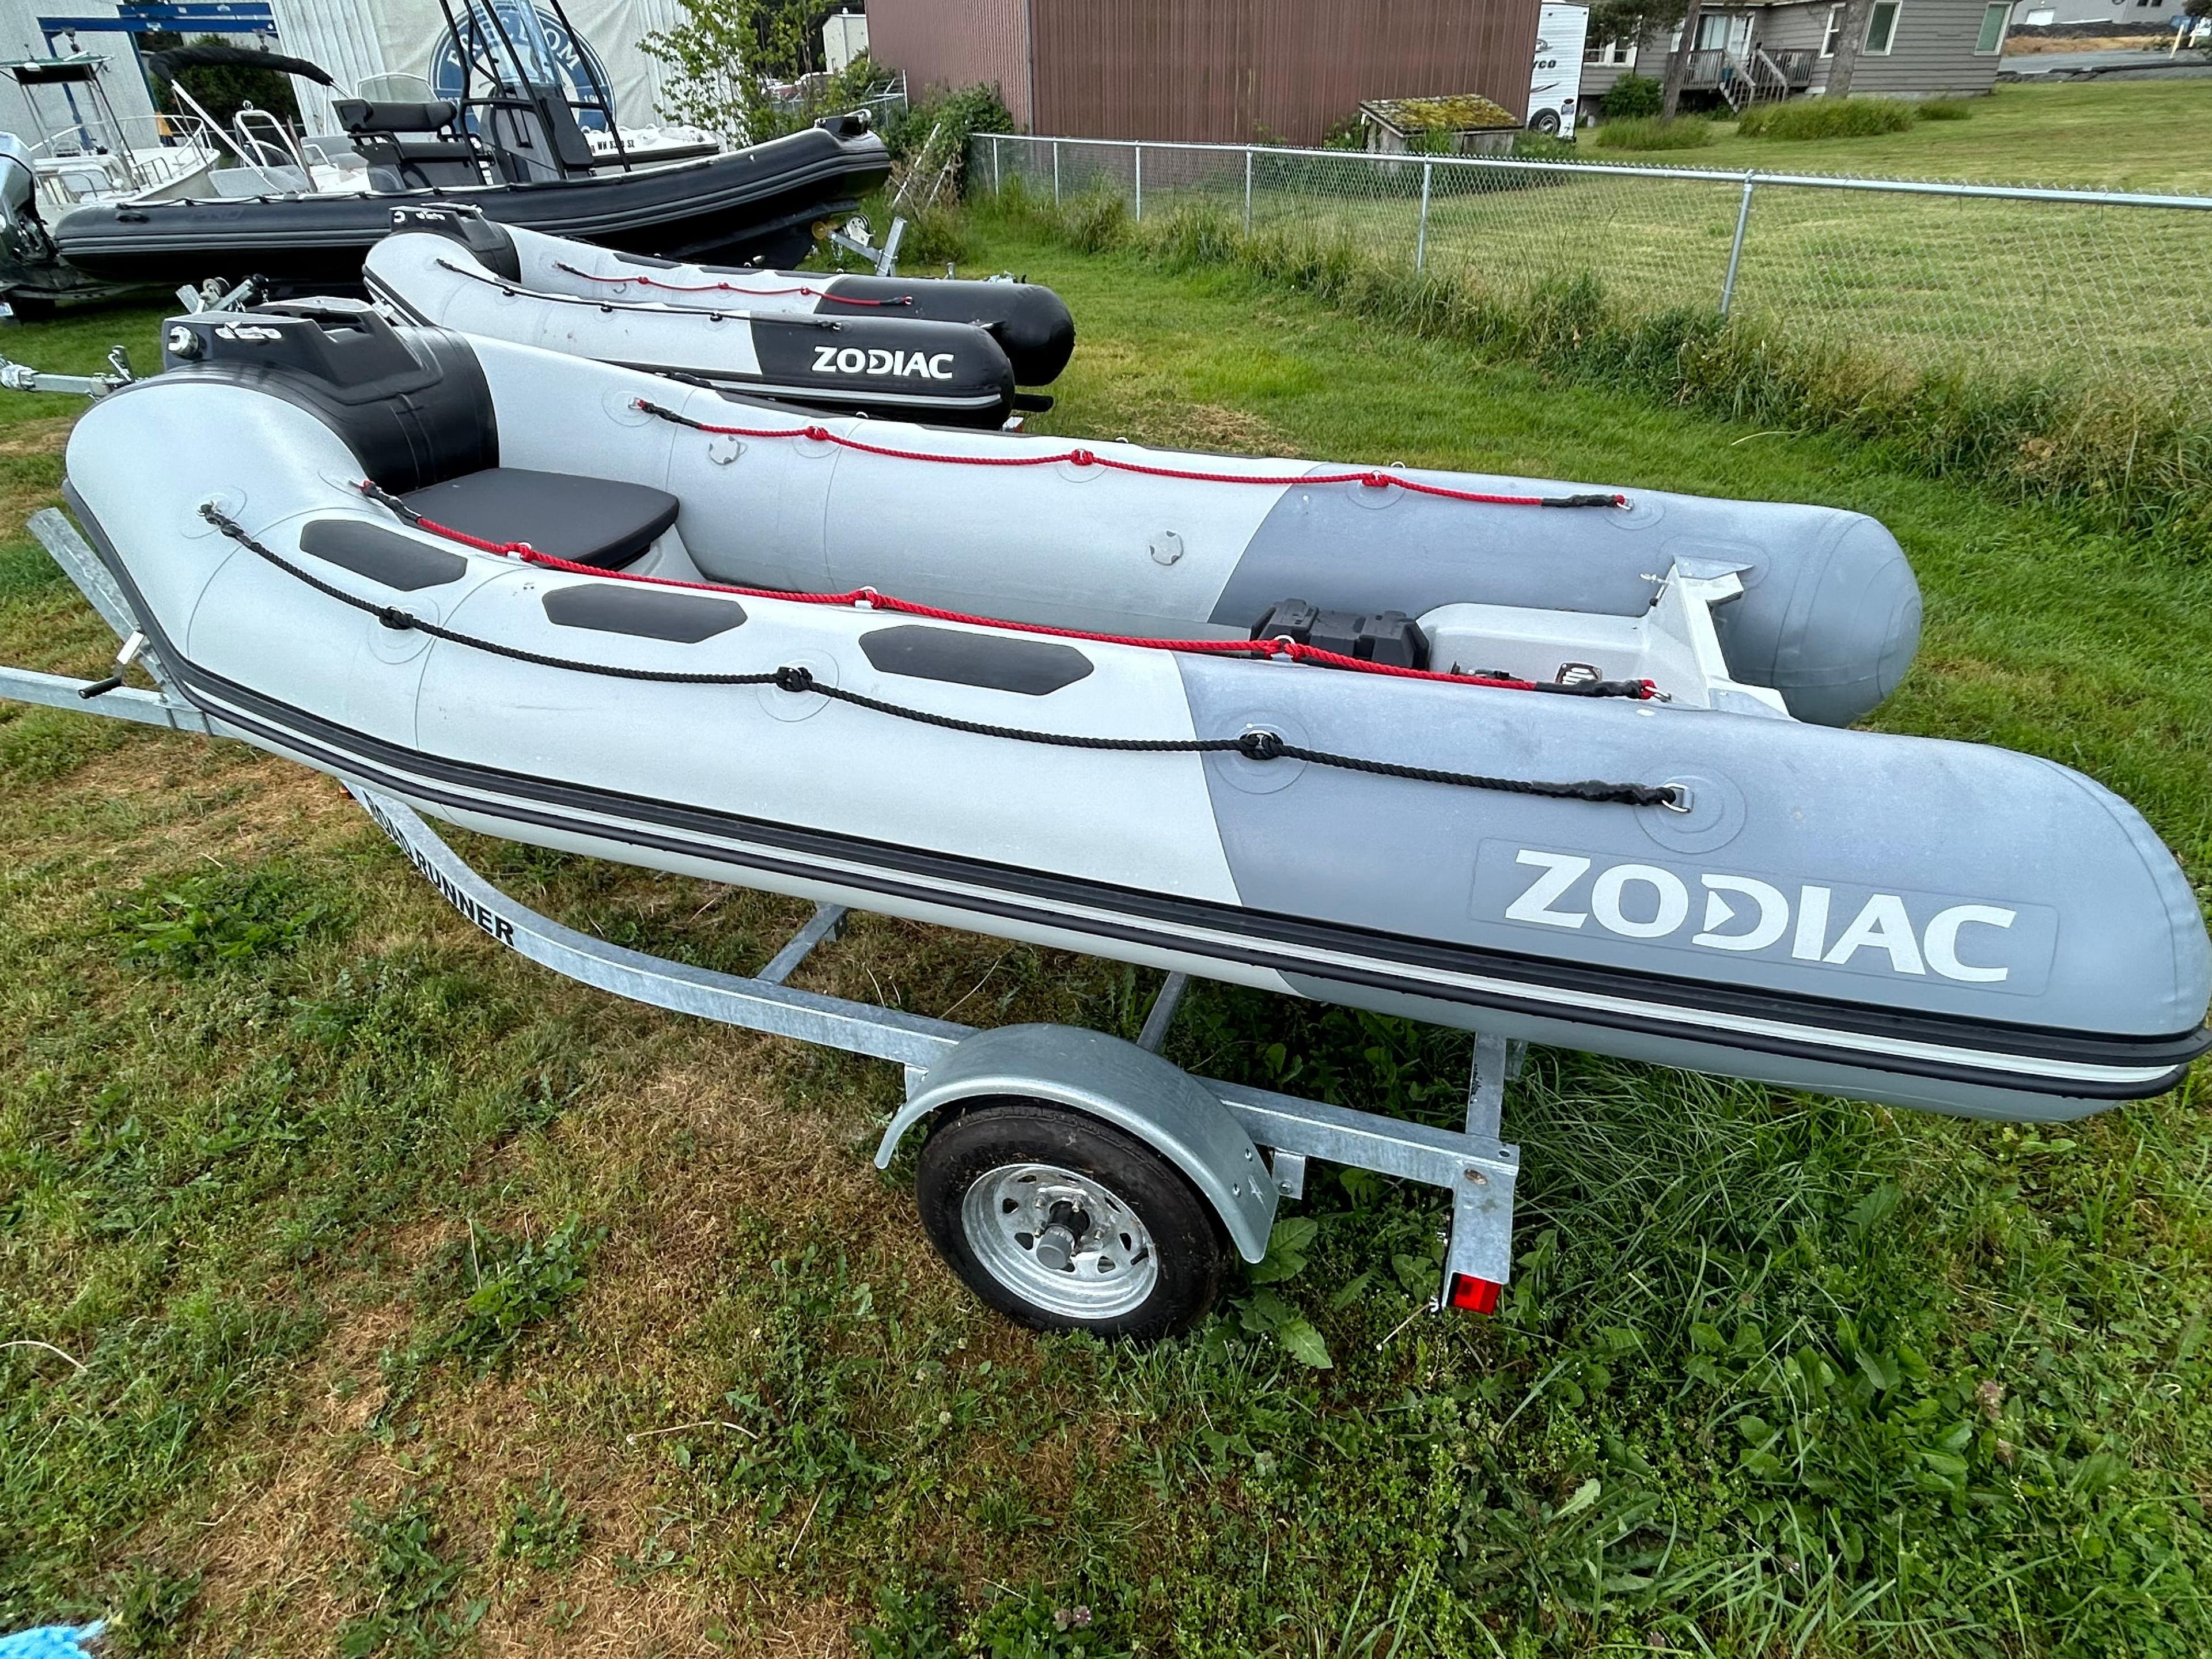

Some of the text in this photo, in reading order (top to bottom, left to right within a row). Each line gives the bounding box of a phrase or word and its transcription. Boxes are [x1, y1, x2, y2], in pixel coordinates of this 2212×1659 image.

[446, 16, 581, 70] FROM
[811, 346, 955, 379] ZODIAC
[415, 847, 514, 947] RUNNER
[1504, 849, 2017, 983] ZODIAC
